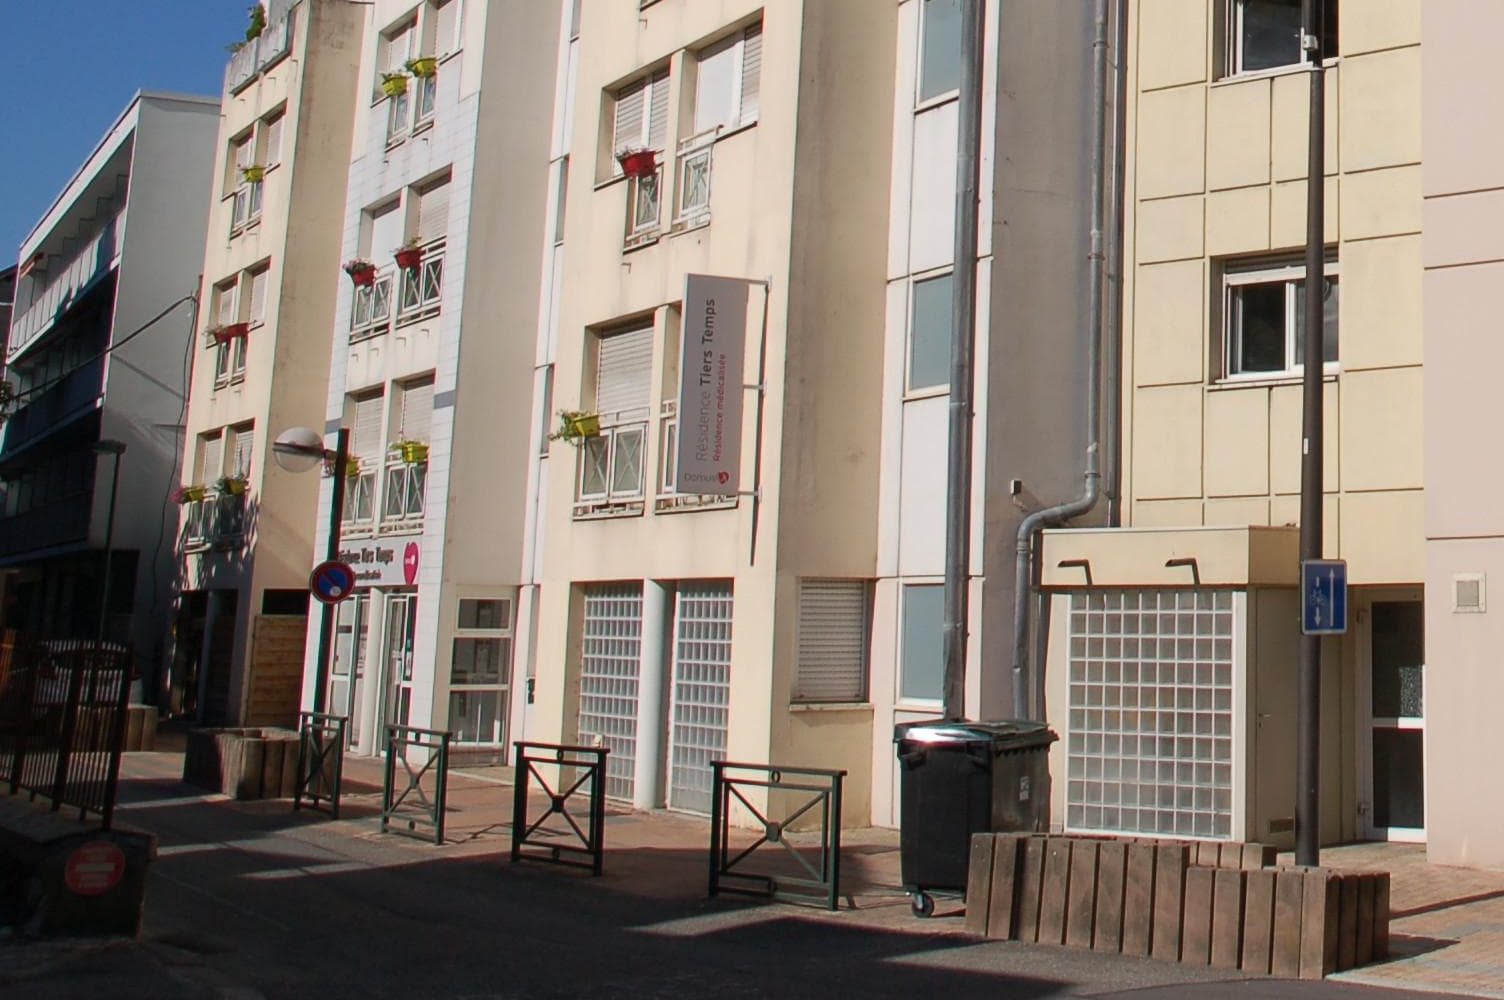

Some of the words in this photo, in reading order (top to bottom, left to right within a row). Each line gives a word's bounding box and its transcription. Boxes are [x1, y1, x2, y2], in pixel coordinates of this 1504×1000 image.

[702, 298, 717, 345] Temps
[699, 349, 713, 387] Tiers
[695, 391, 711, 461] Résidence
[712, 412, 724, 462] Résidence
